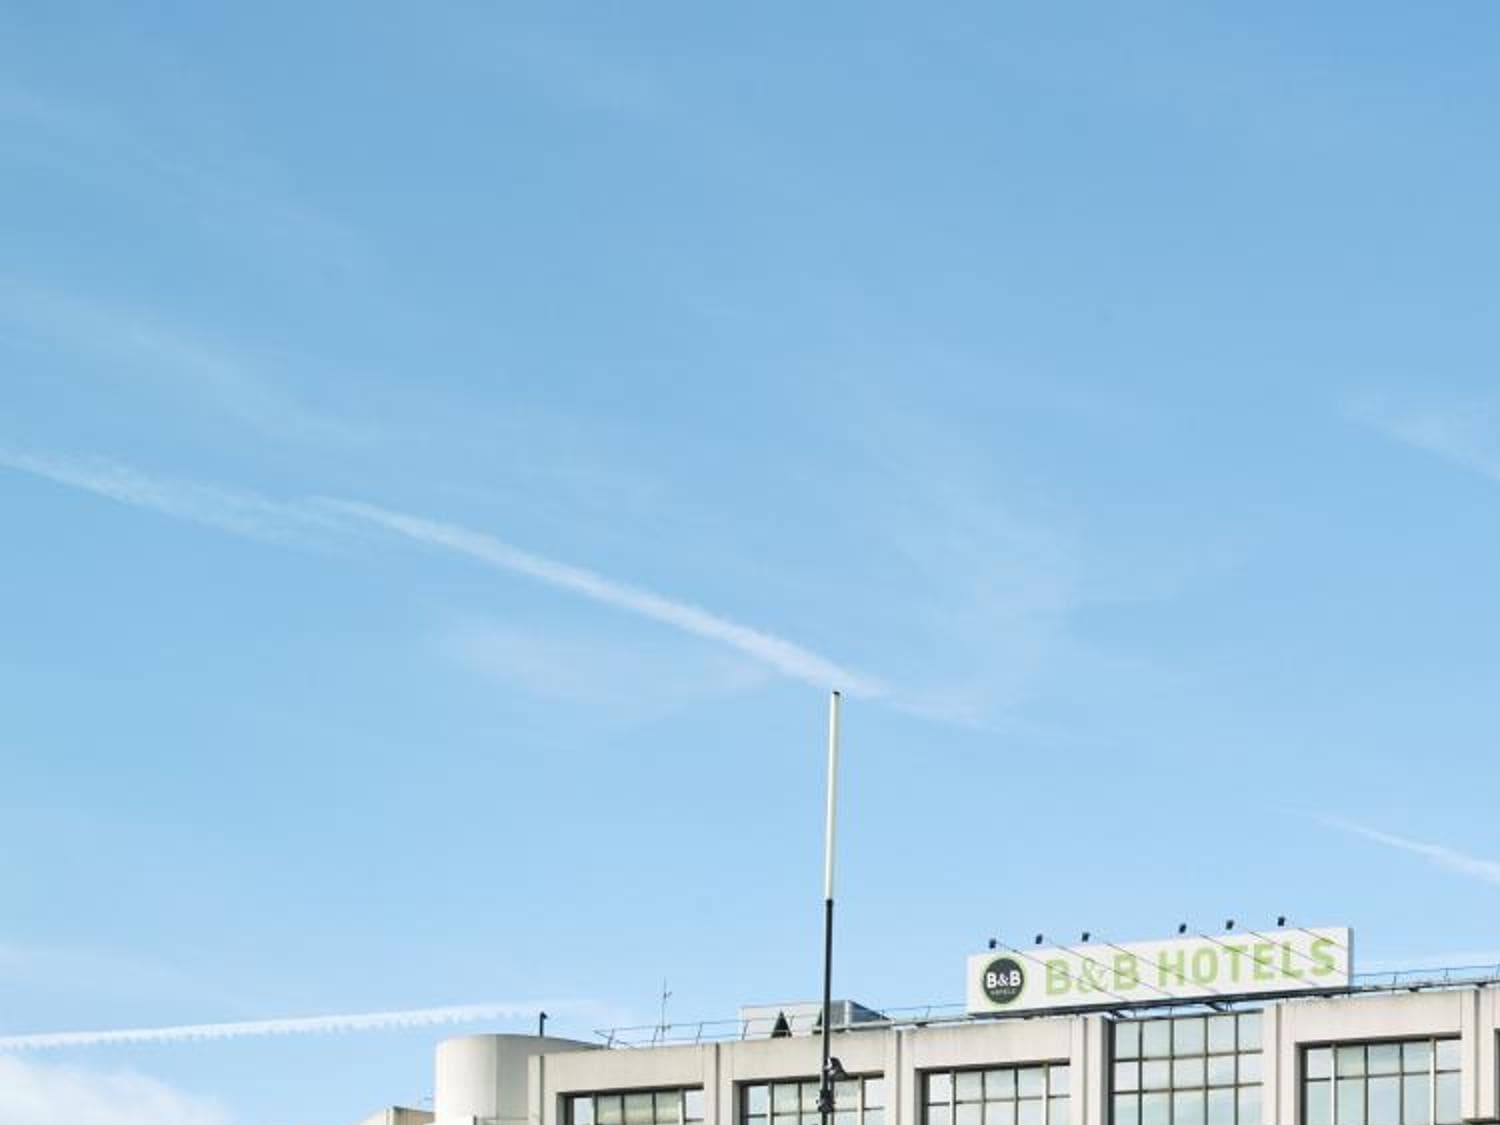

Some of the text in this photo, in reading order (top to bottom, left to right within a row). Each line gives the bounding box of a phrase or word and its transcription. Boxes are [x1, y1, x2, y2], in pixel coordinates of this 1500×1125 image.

[986, 970, 1021, 989] B&B
[1044, 937, 1336, 995] B&B HOTELS
